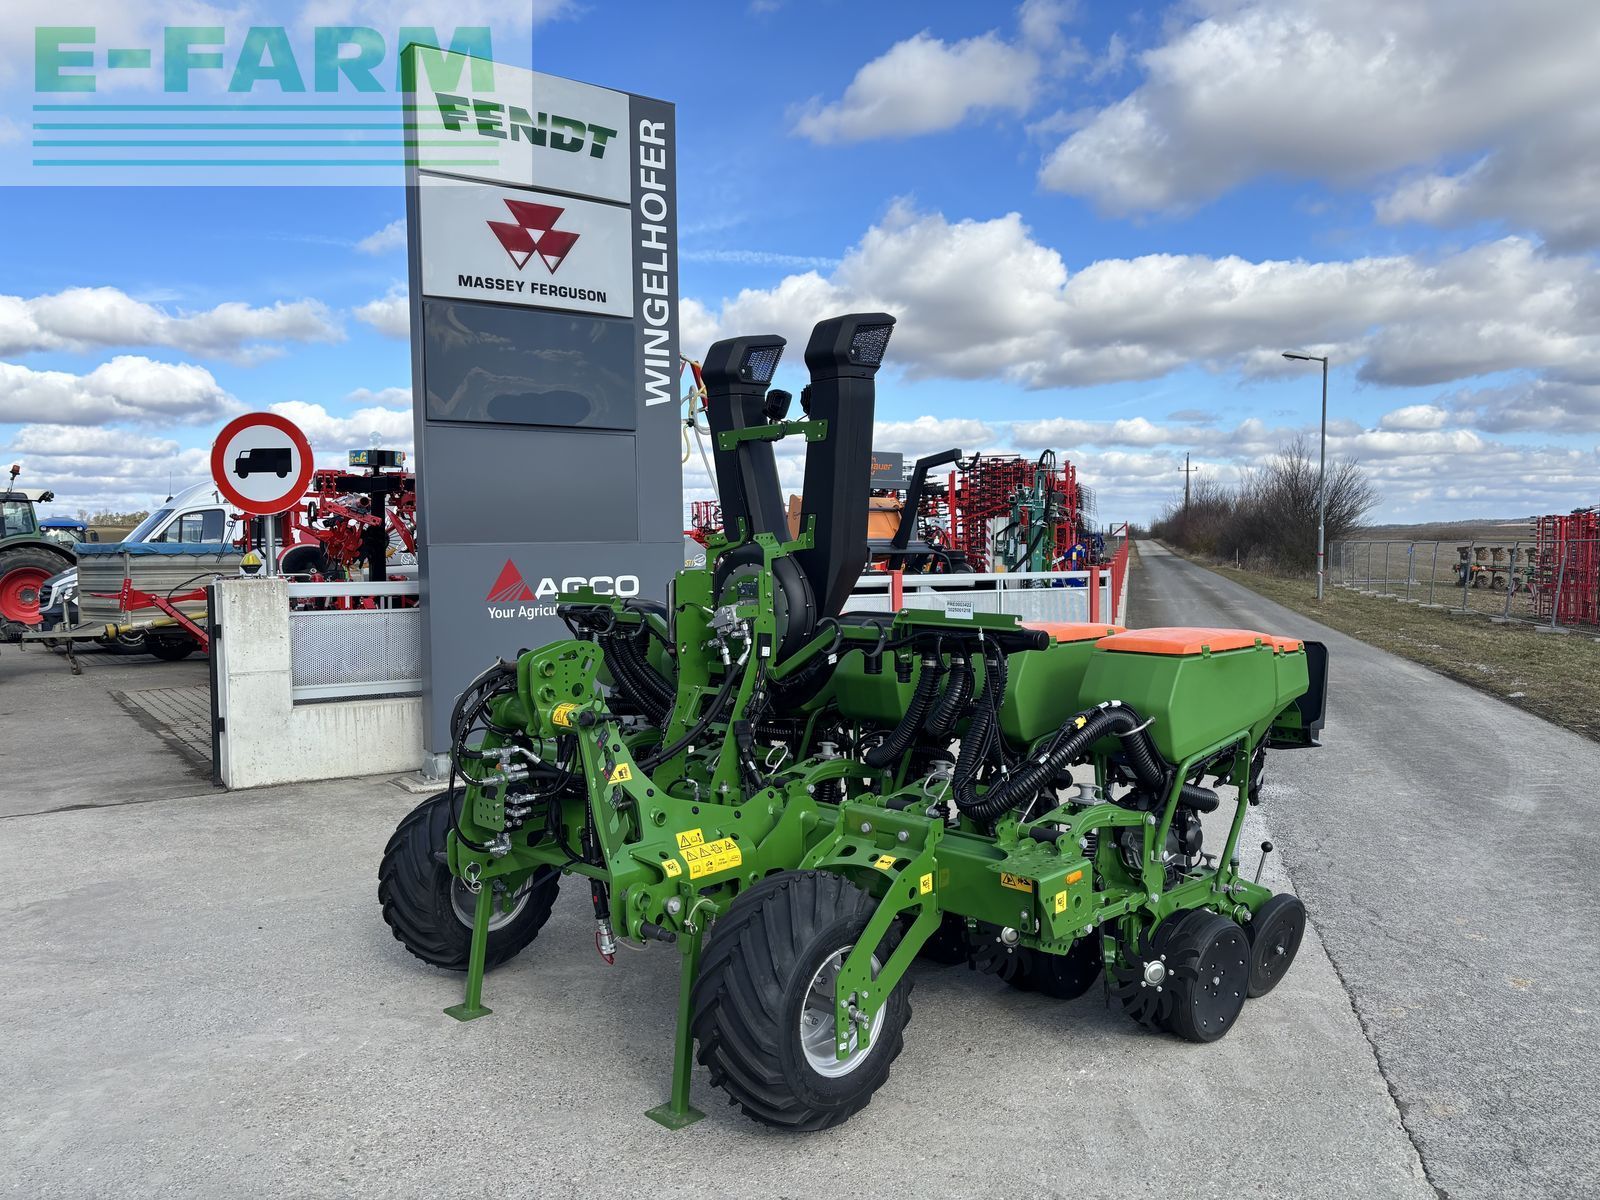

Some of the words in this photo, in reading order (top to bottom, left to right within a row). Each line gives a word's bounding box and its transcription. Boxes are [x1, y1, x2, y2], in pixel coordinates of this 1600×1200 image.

[434, 92, 618, 160] FENDT
[638, 118, 672, 407] WINGELHOFER
[458, 274, 525, 293] MASSEY
[530, 282, 607, 303] FERGUSON
[535, 575, 640, 600] AGCO
[488, 606, 516, 619] Your
[518, 603, 560, 620] Agricu
